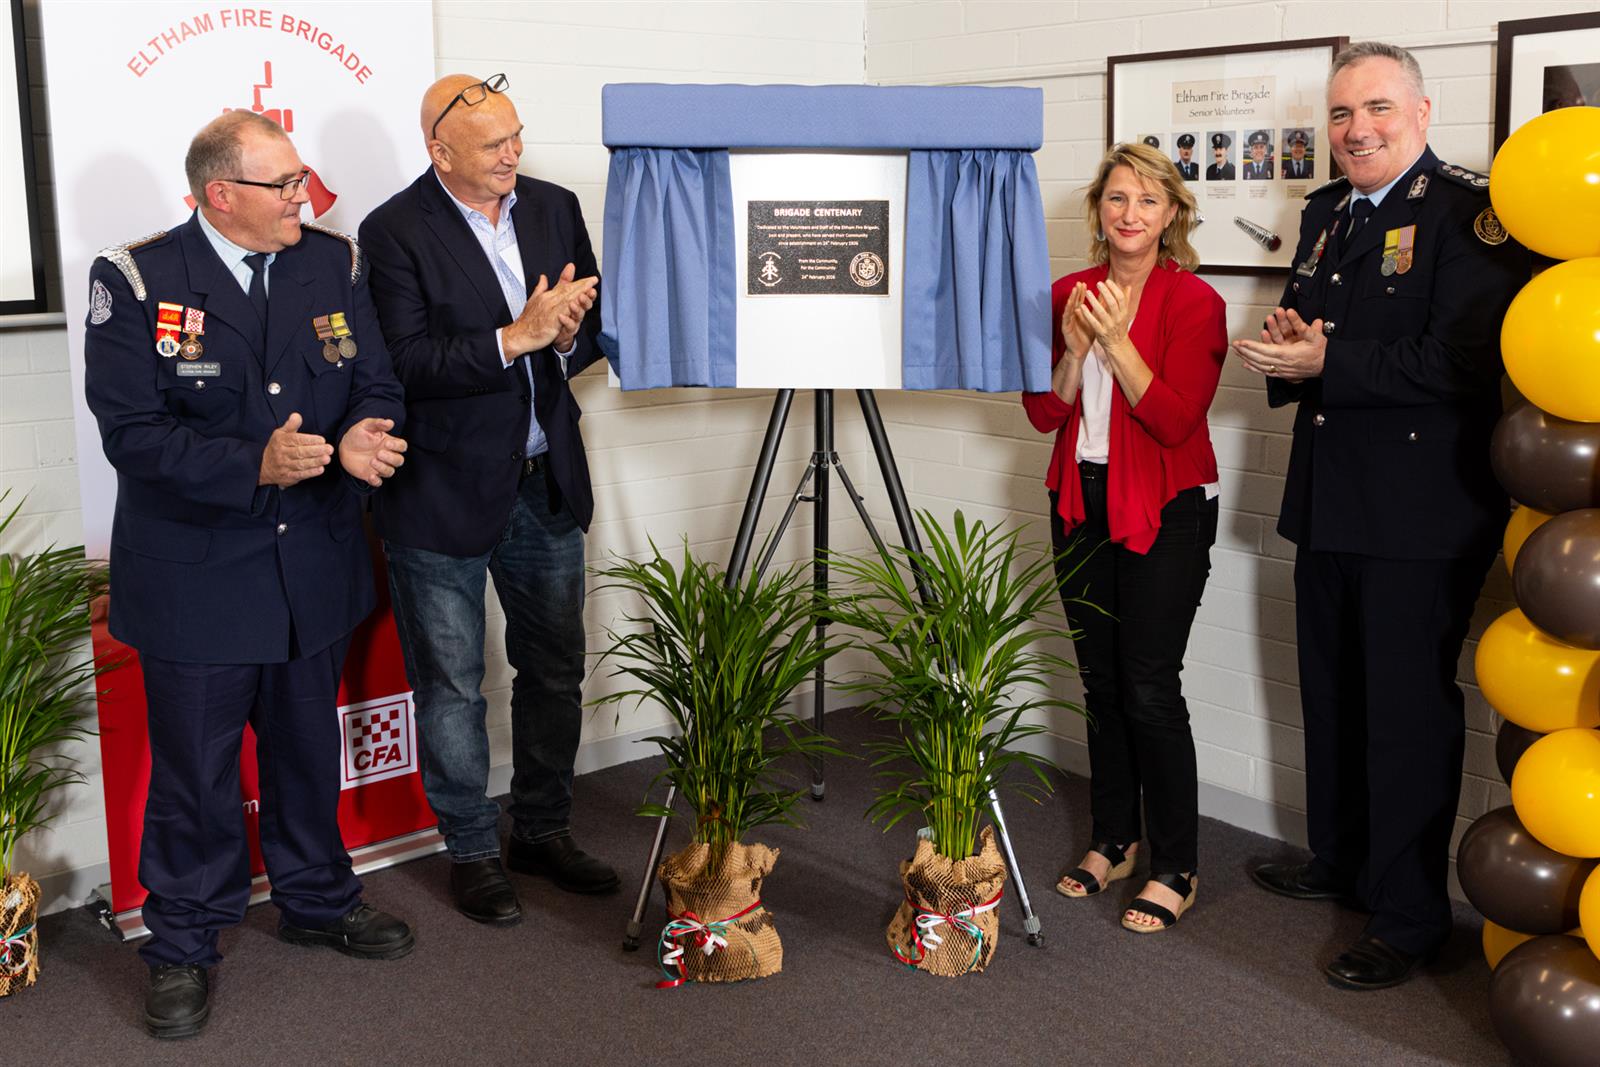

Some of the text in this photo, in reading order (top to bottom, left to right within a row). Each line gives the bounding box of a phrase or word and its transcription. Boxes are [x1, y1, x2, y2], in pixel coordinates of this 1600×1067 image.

[127, 8, 373, 84] ELTHAM FIRE BRIGADE
[1176, 85, 1271, 104] Eltham Fire Brigade
[1188, 106, 1255, 118] Senior Volunteers
[774, 208, 863, 217] BRIGADE CENTENARY
[353, 743, 402, 771] CFA
